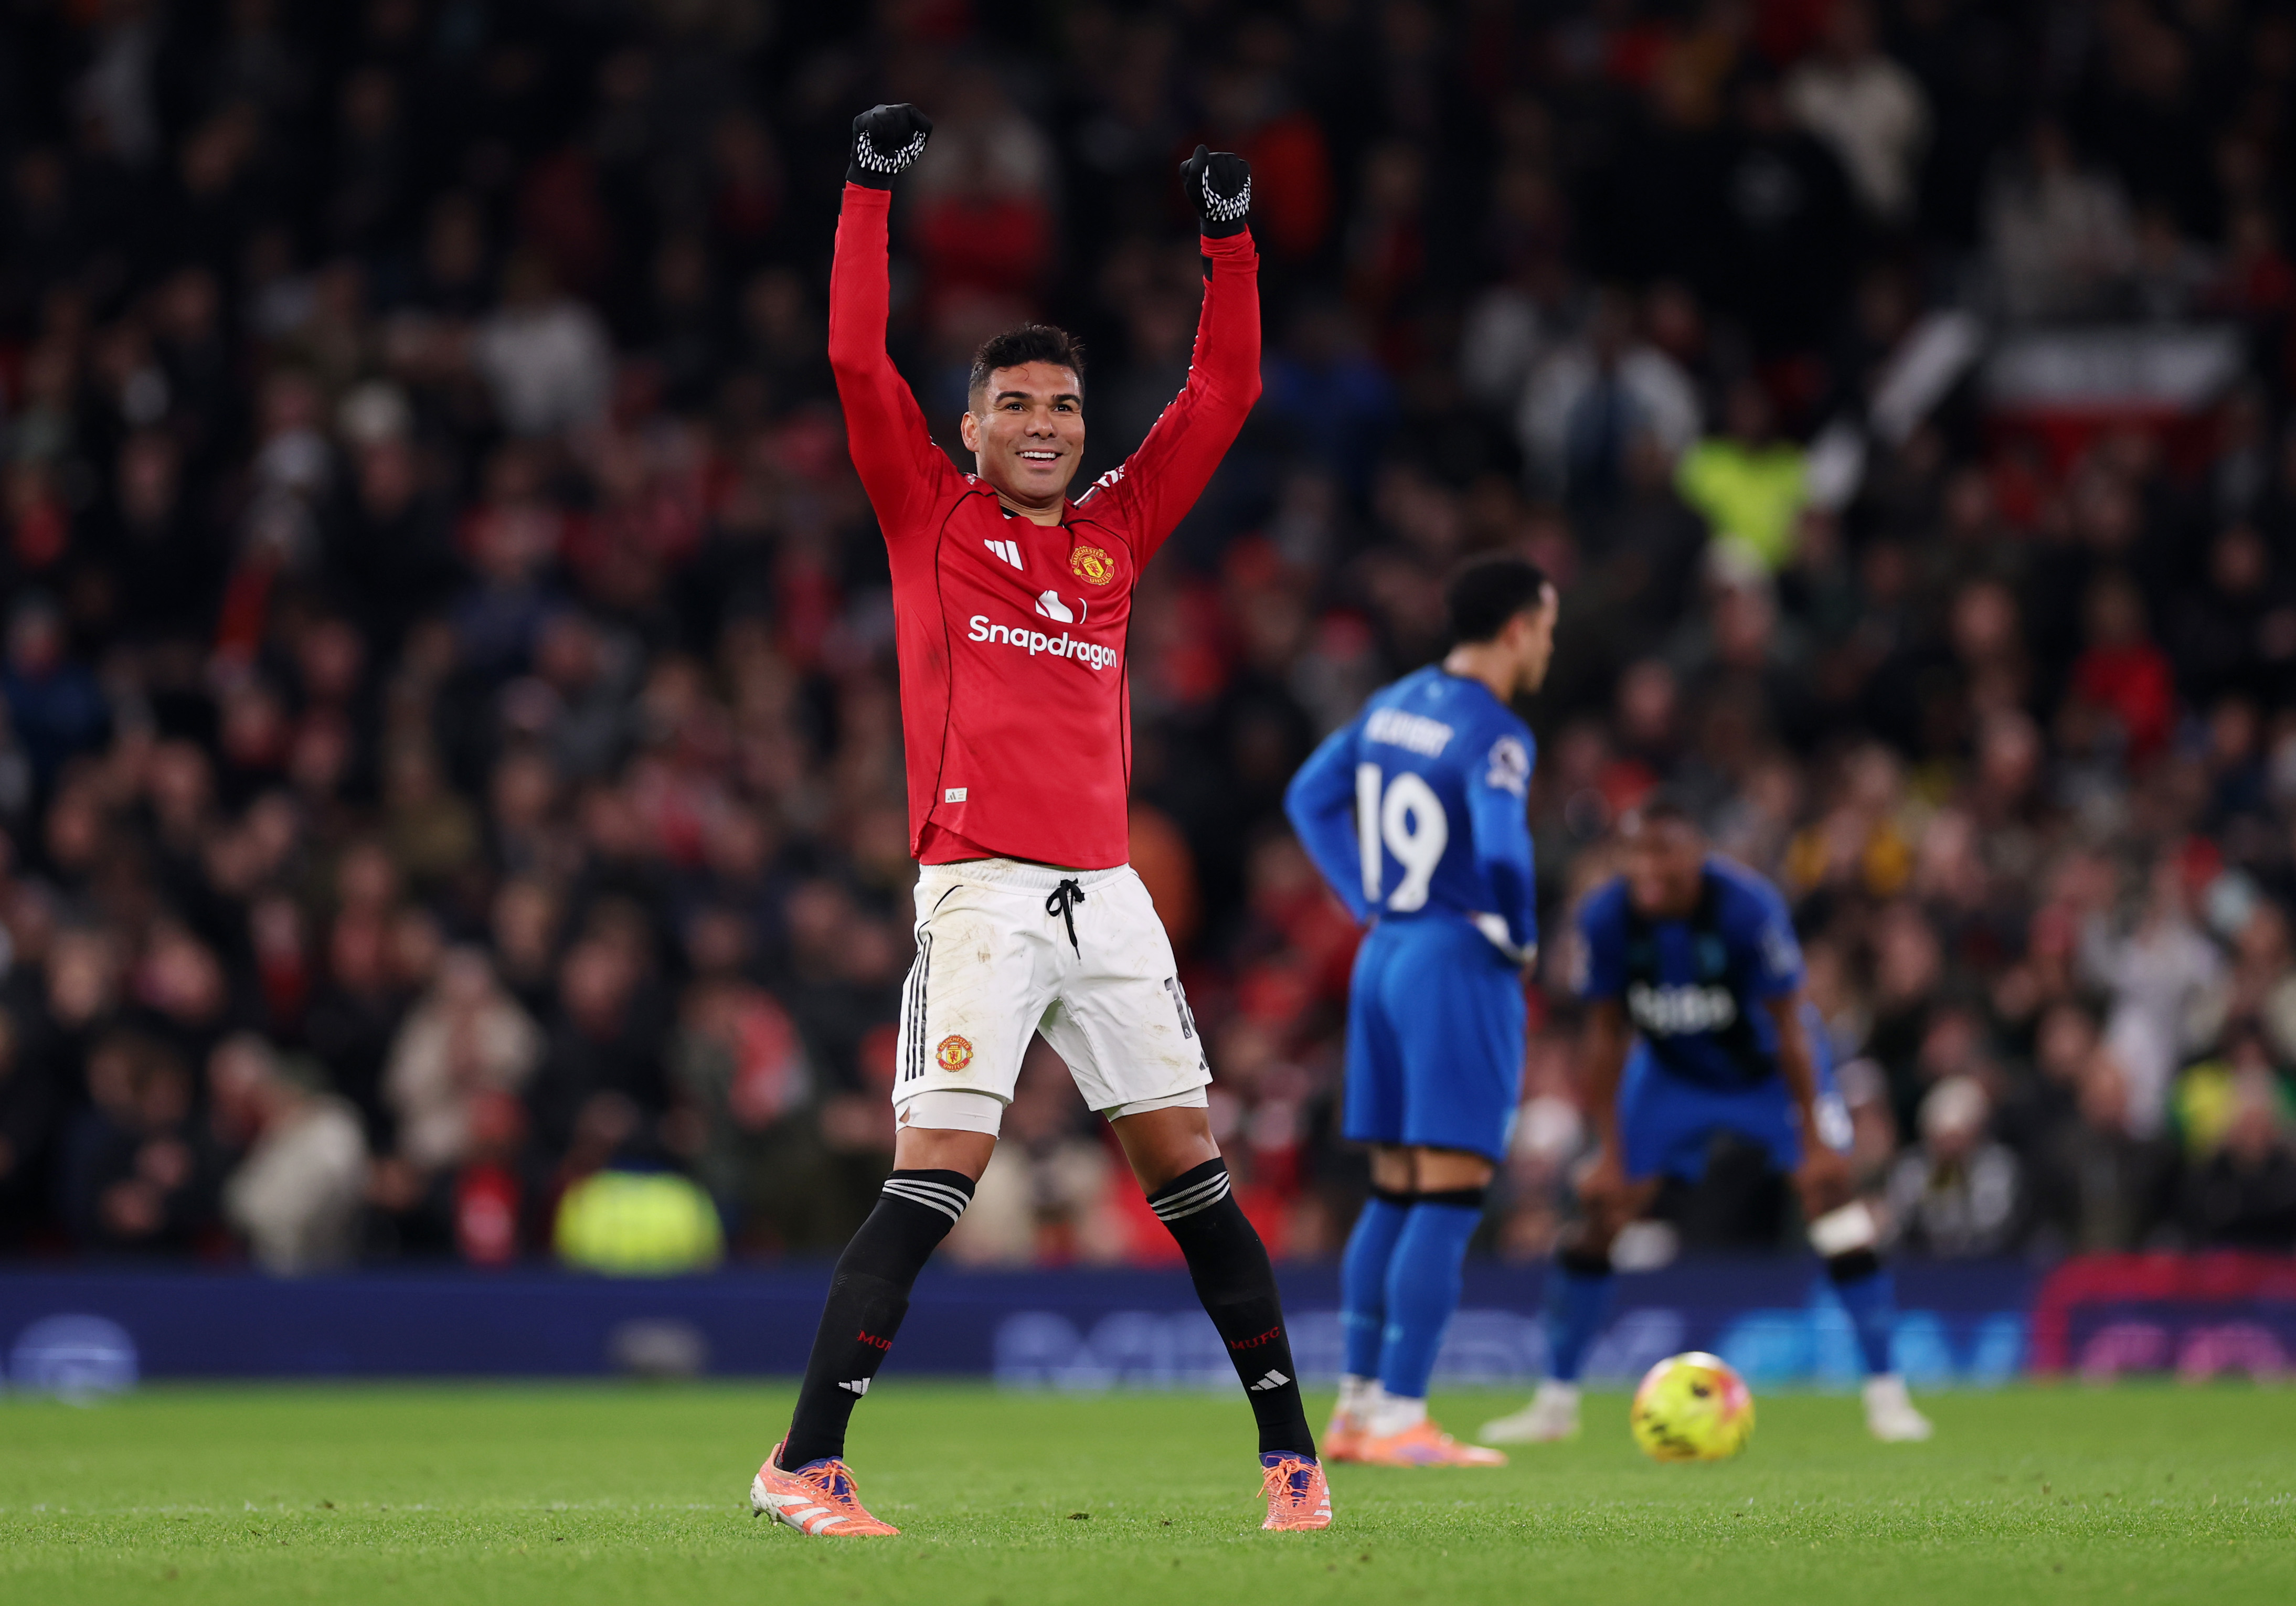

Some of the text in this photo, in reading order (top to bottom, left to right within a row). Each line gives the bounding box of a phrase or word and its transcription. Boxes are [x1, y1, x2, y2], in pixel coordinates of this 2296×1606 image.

[1072, 548, 1104, 566] MANCHESTER
[1090, 572, 1112, 583] UNITED
[968, 615, 1117, 671] Snapdragon
[1356, 762, 1449, 912] 19
[940, 1037, 970, 1050] MANCHESTER
[1230, 1326, 1280, 1350] MUFC
